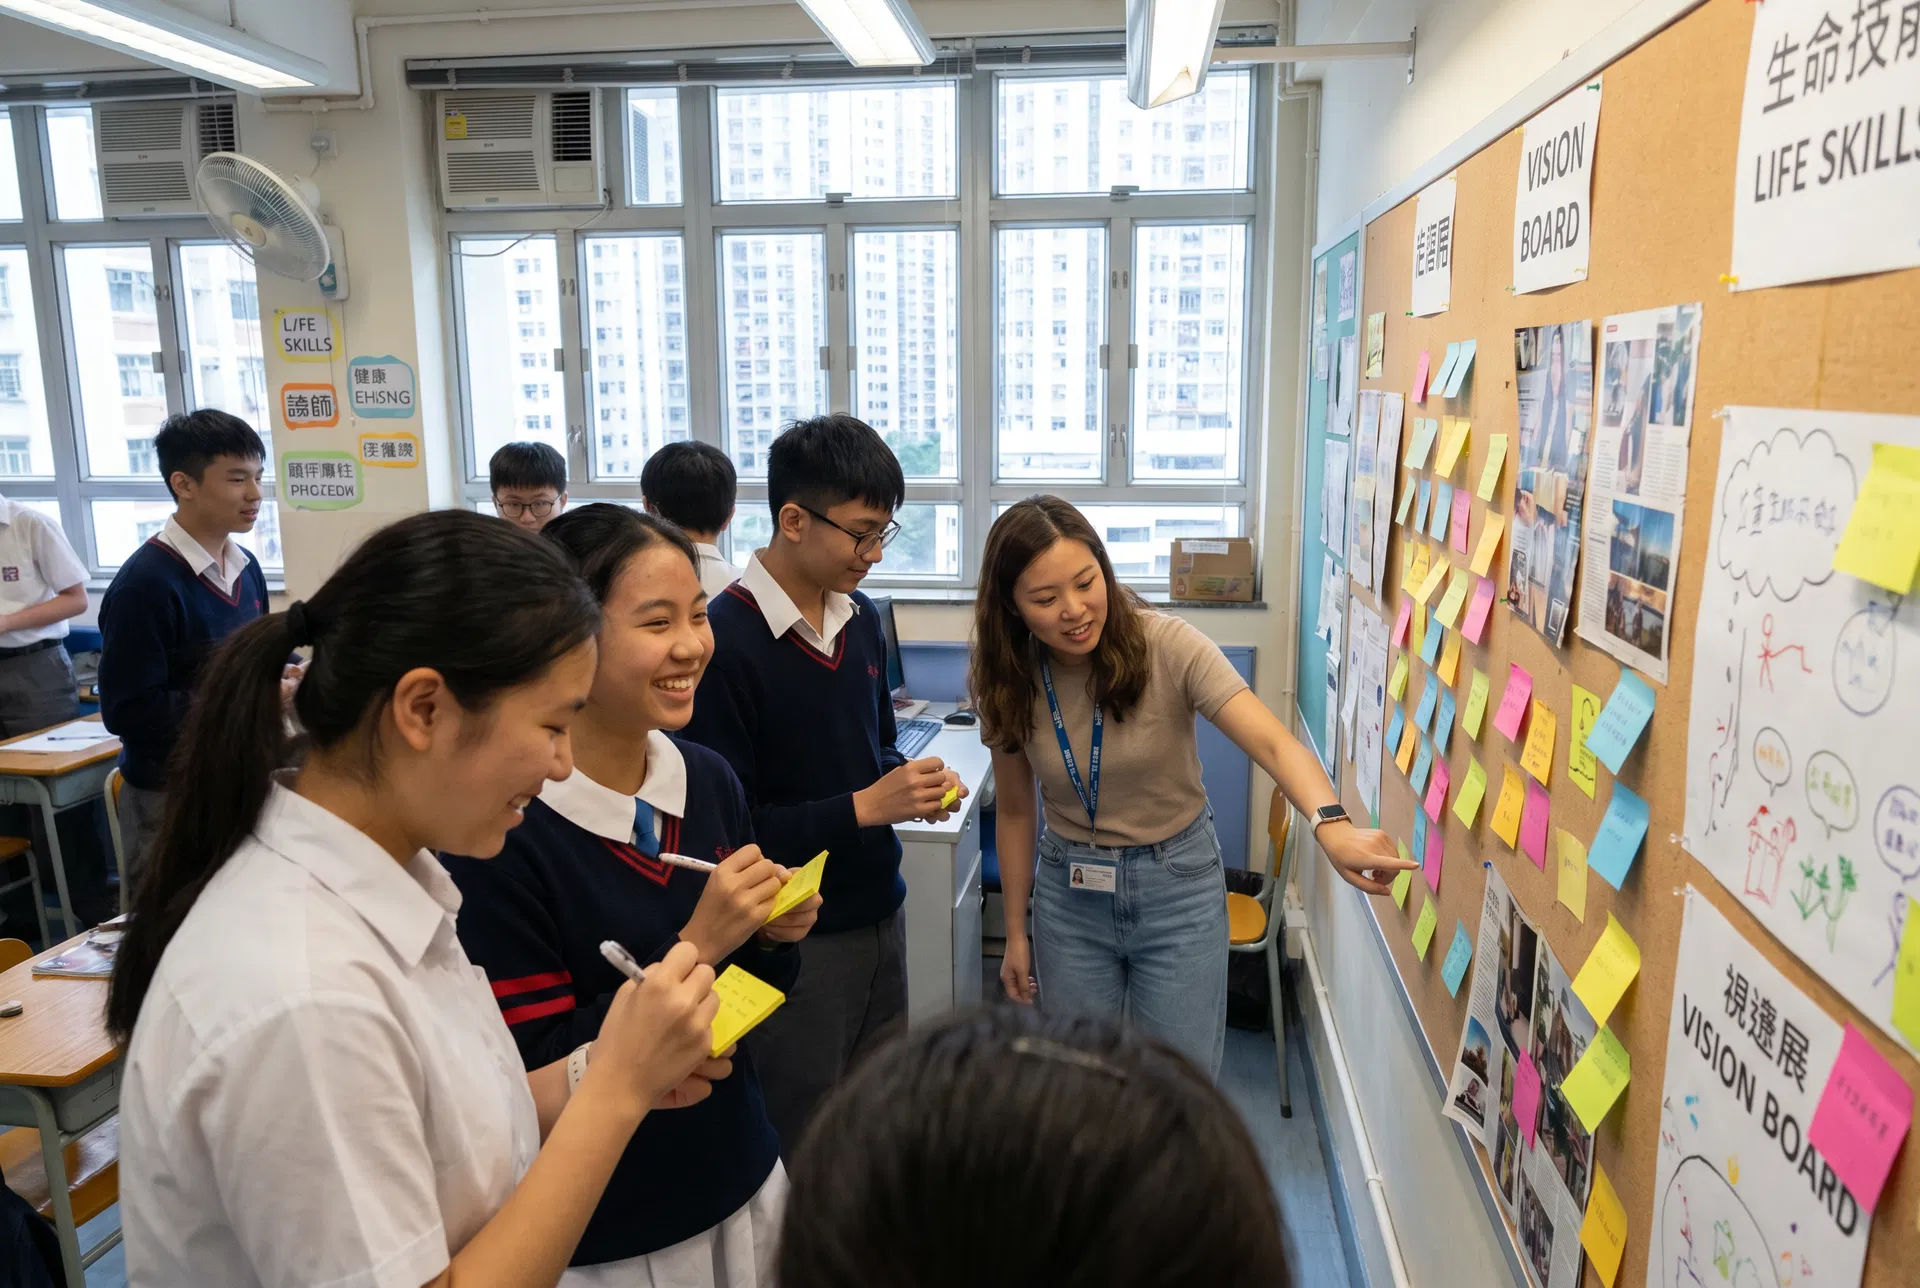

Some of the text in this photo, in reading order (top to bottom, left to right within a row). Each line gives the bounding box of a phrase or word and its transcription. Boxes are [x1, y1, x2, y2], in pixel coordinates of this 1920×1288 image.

[1528, 122, 1586, 192] VISION
[1755, 139, 1810, 202] LIFE
[1520, 201, 1580, 263] BOARD
[283, 317, 316, 332] LIFE
[284, 337, 333, 352] SKILLS
[1683, 993, 1859, 1237] VISION BOARD
